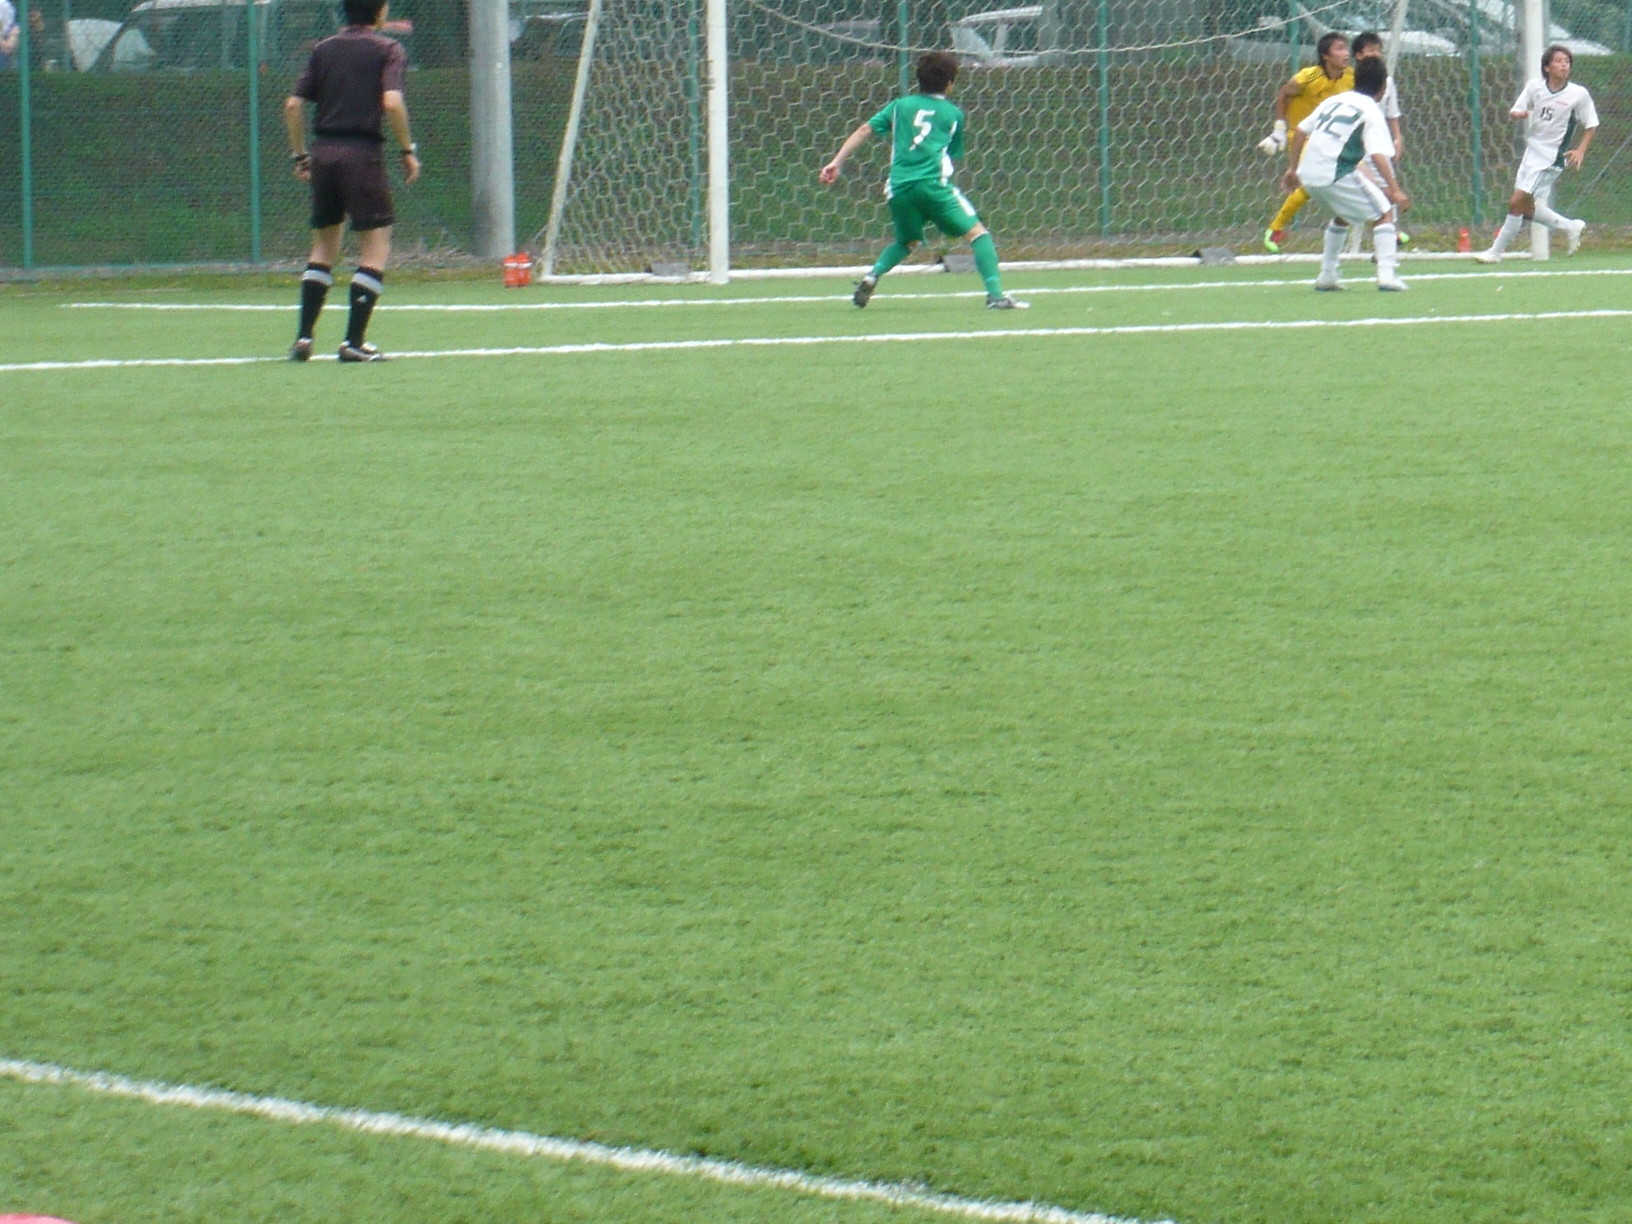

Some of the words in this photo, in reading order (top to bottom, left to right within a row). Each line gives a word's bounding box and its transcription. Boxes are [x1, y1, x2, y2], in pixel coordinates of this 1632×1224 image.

[909, 109, 936, 151] 5
[1316, 102, 1364, 138] 42
[1540, 106, 1555, 121] 15
